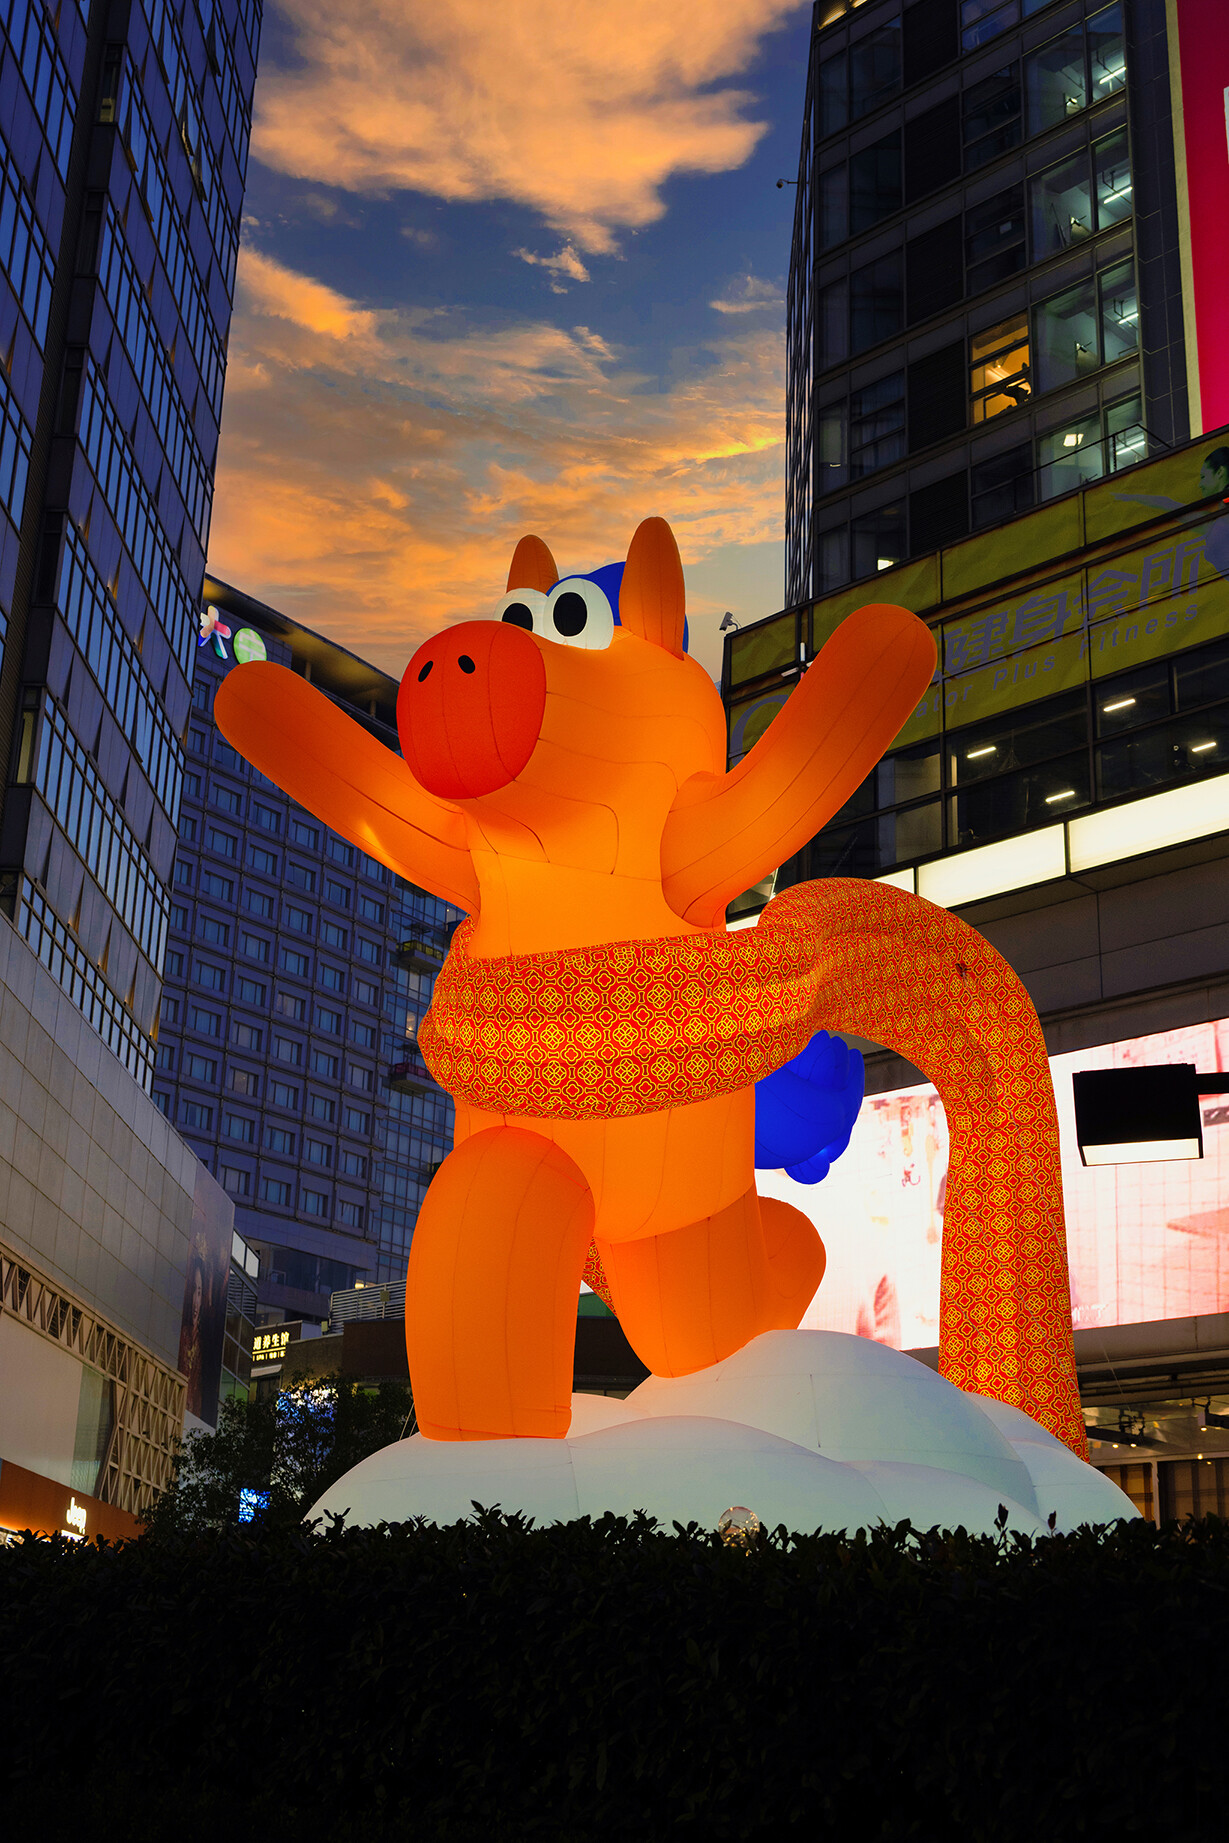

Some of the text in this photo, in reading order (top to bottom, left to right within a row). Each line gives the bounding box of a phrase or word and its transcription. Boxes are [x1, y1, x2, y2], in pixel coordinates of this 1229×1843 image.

[916, 604, 1198, 718] ator Plus Fitness
